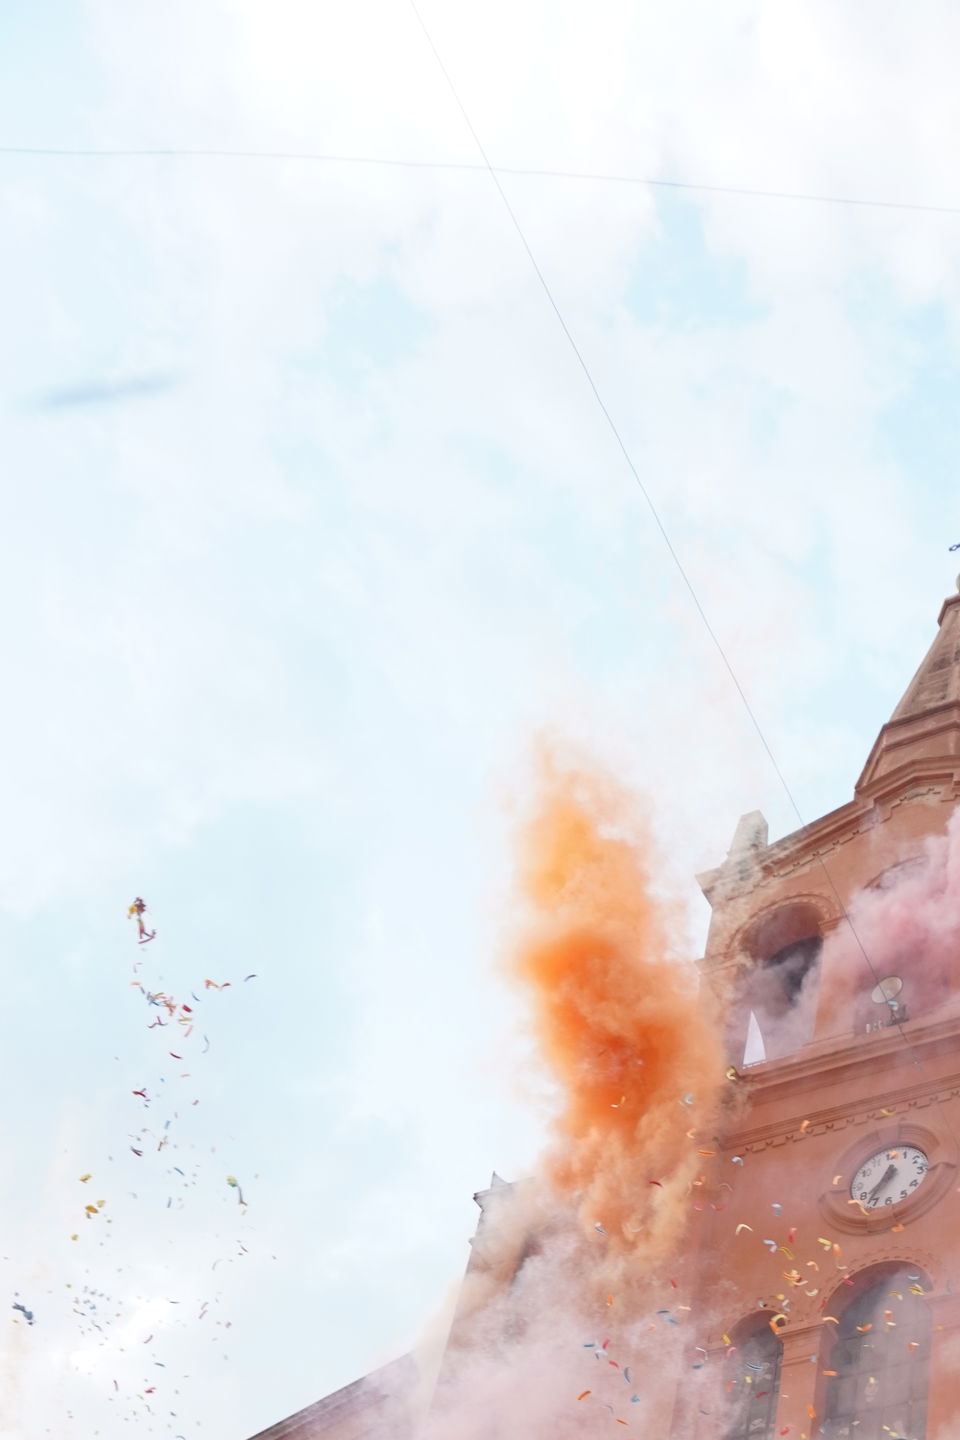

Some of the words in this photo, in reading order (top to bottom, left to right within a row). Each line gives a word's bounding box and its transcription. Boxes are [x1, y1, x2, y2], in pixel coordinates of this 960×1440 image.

[912, 1155, 920, 1164] 2
[917, 1166, 924, 1175] 3
[909, 1179, 919, 1187] 4
[860, 1191, 868, 1200] 8
[900, 1190, 907, 1198] 5
[885, 1197, 892, 1205] 6
